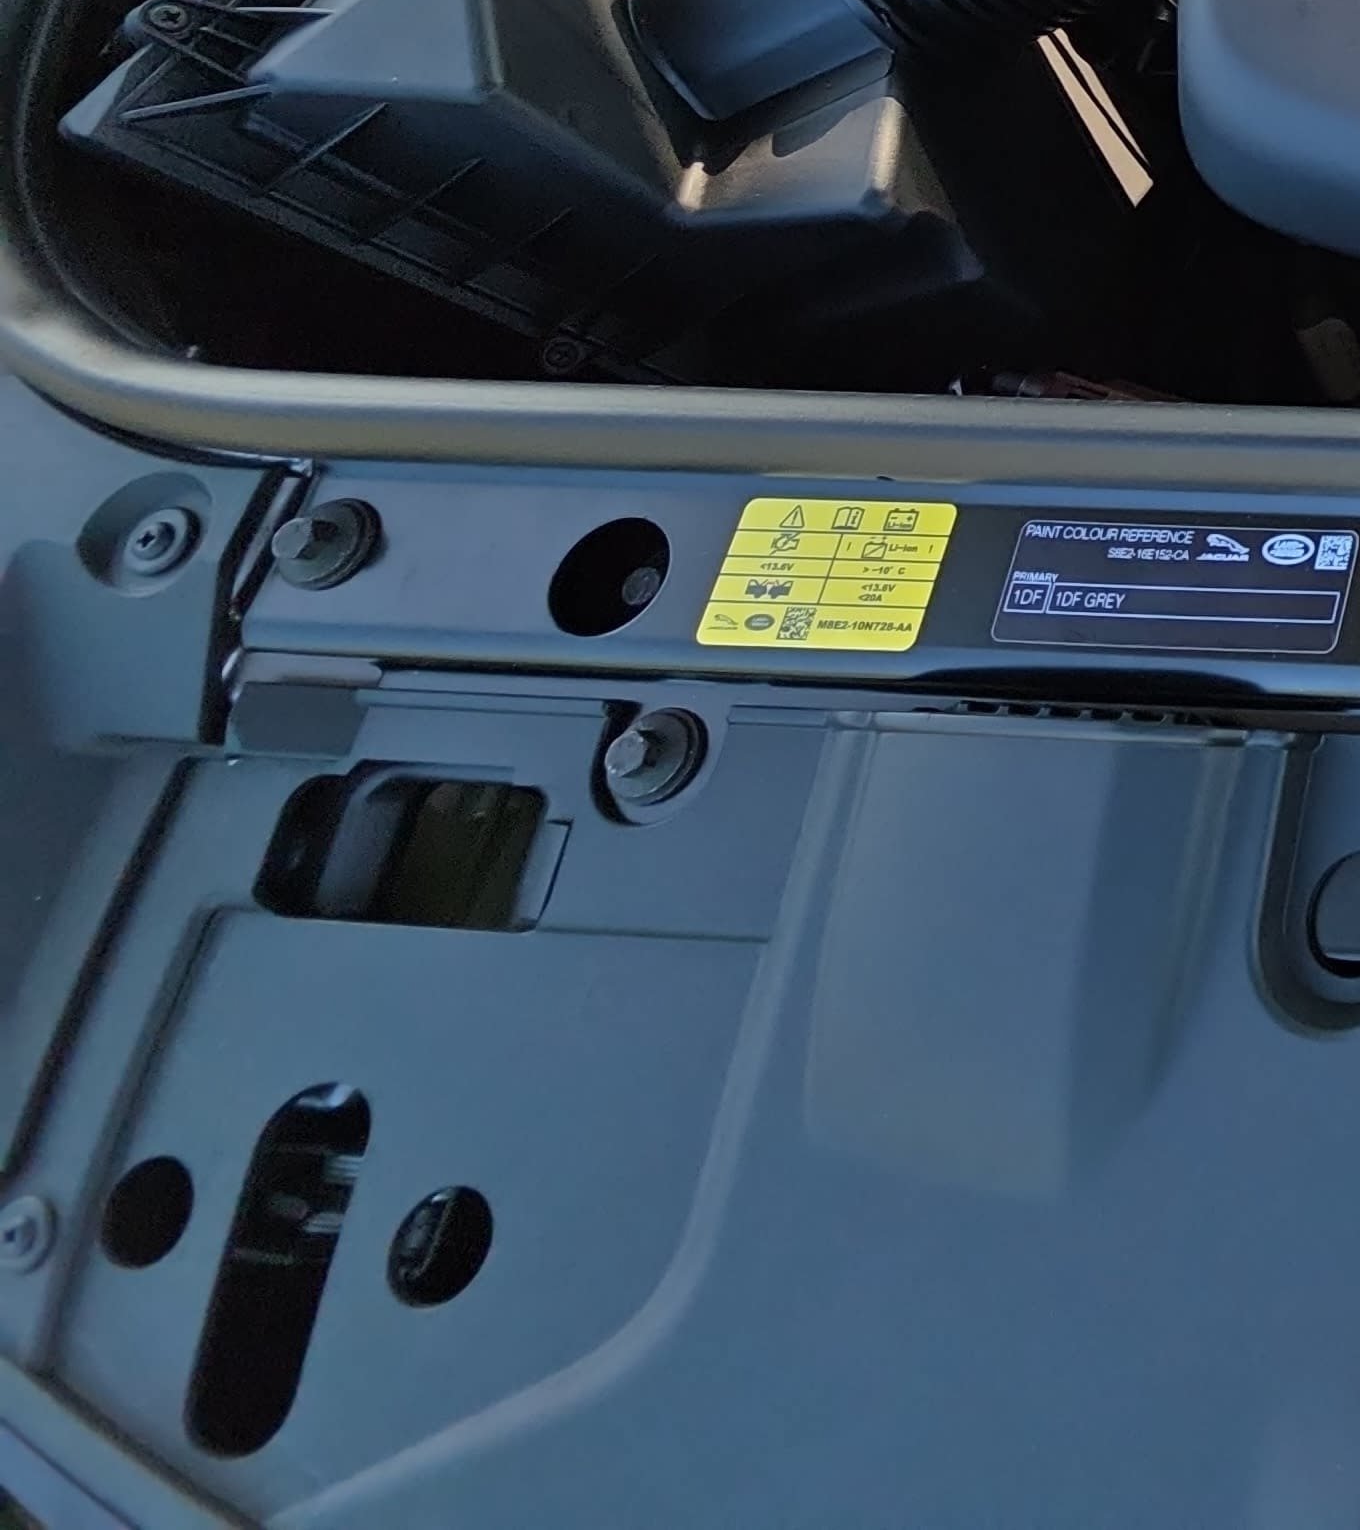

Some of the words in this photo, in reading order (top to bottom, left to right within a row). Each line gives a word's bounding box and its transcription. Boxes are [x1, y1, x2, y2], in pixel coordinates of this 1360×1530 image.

[1024, 523, 1064, 539] PAINT
[1063, 526, 1119, 542] COLOUR
[1118, 528, 1196, 545] REFERENCE
[1012, 570, 1059, 583] PRIMARY
[1013, 588, 1044, 605] 1DF
[1055, 591, 1083, 607] 1DF
[1083, 592, 1126, 609] GREY
